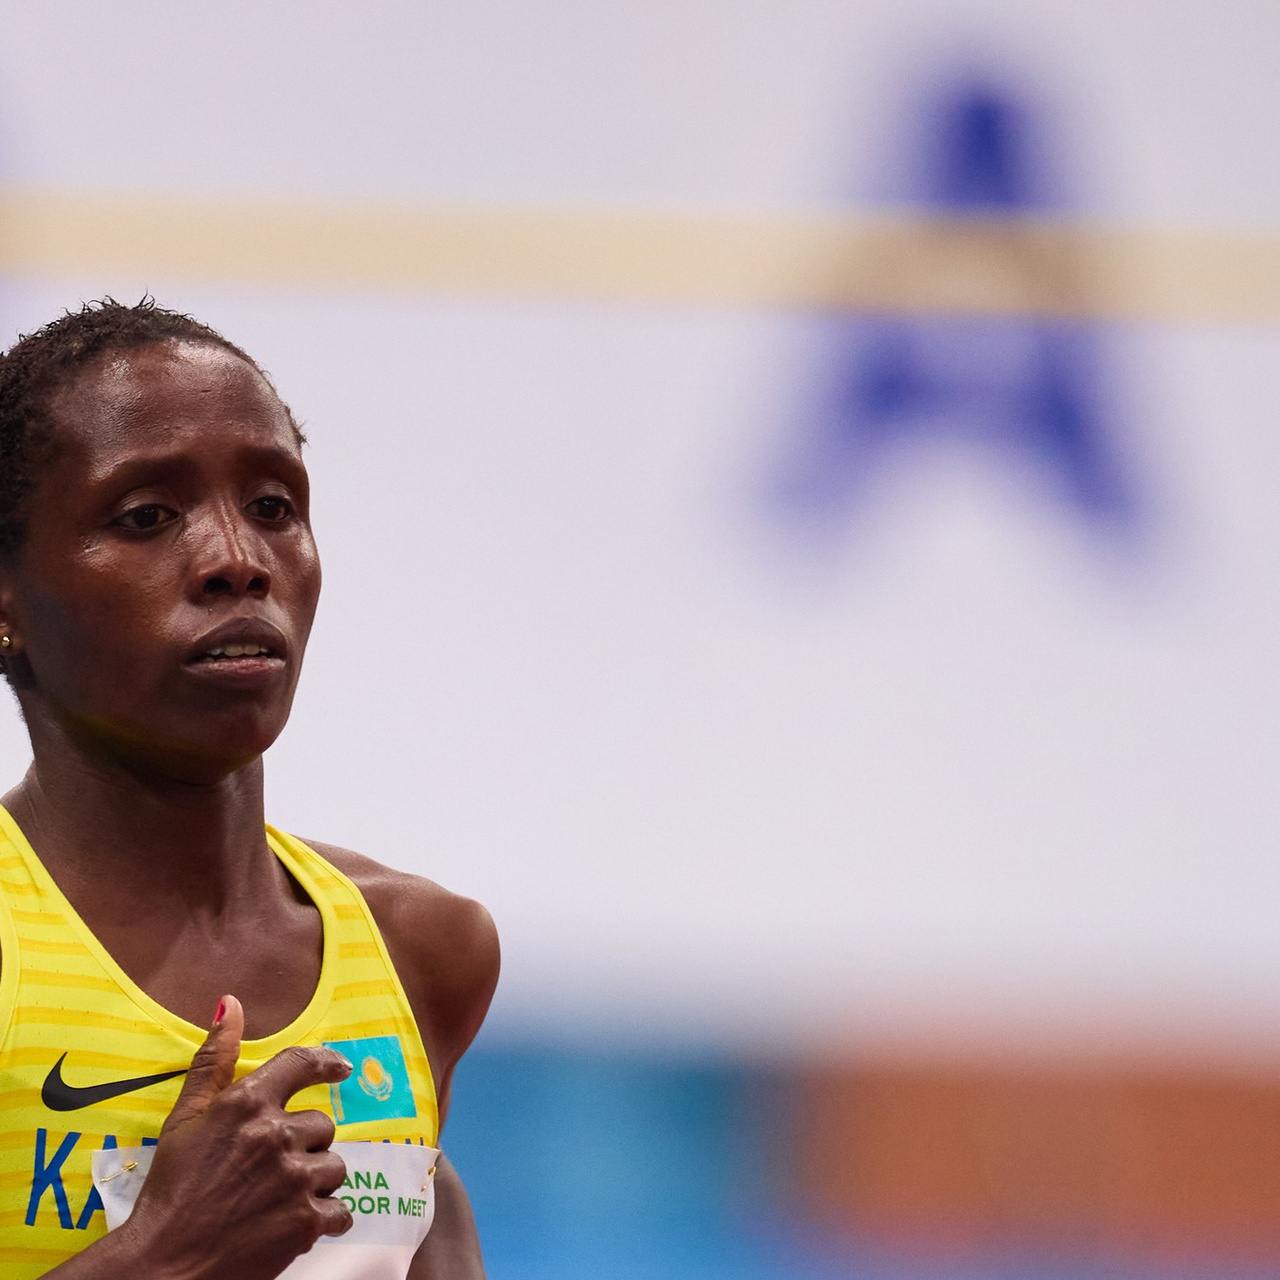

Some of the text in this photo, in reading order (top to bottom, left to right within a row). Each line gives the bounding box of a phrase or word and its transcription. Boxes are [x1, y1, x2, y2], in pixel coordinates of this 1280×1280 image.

[341, 1171, 390, 1190] ANA
[339, 1195, 427, 1218] OOR MEET
